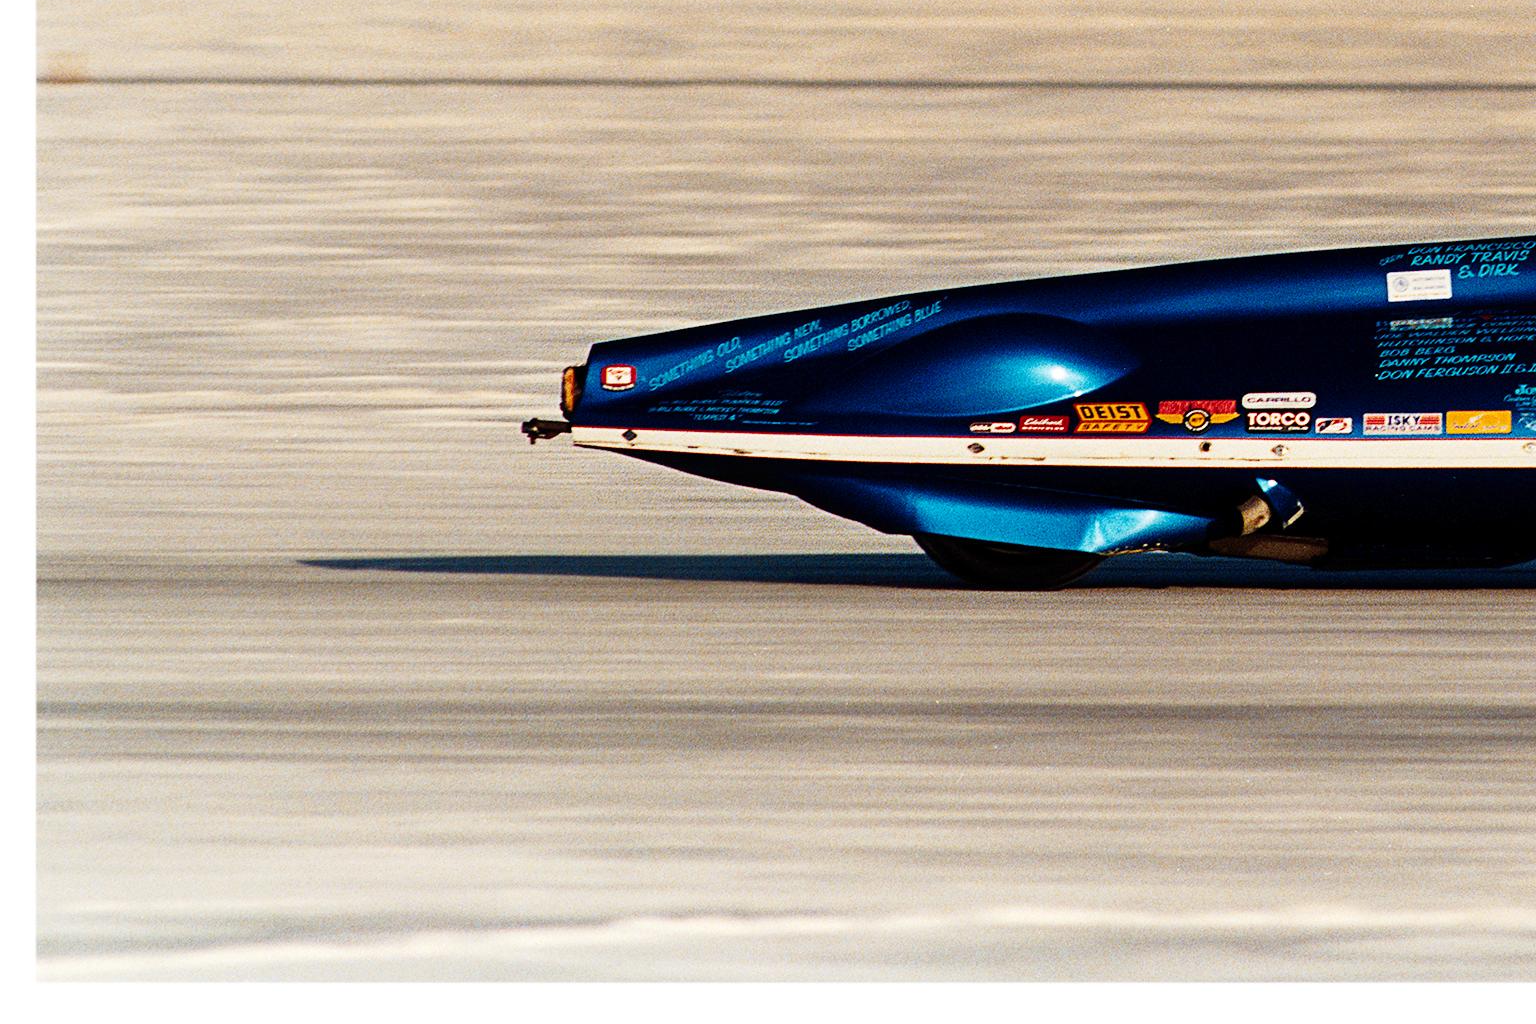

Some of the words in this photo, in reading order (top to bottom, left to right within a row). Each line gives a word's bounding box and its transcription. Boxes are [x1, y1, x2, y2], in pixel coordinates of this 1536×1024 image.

[1407, 246, 1440, 255] DON
[1445, 241, 1536, 253] FRANCISCO
[1410, 253, 1466, 266] RANDY
[1471, 250, 1530, 262] TRAVIS
[1457, 265, 1474, 278] &
[1477, 263, 1520, 278] DIRK
[847, 313, 912, 352] SOMETHING
[783, 323, 849, 363] SOMETHING
[1377, 337, 1477, 348] HUTCHINSON
[1497, 333, 1536, 342] HOPE
[725, 331, 791, 373] SOMETHING
[1379, 348, 1410, 357] BOB
[1414, 345, 1456, 355] BERG
[1379, 357, 1431, 368] DANNY
[1434, 352, 1517, 365] THOMPSON
[649, 349, 714, 391] SOMETHING
[1378, 370, 1413, 380] DON
[1415, 364, 1499, 378] FERGUSON
[1499, 363, 1515, 375] II
[1247, 396, 1312, 404] CARRILLO
[1080, 405, 1141, 419] DEIST
[1247, 412, 1311, 426] TORCO
[1082, 423, 1144, 431] SAFETY
[1387, 415, 1421, 425] ISKY
